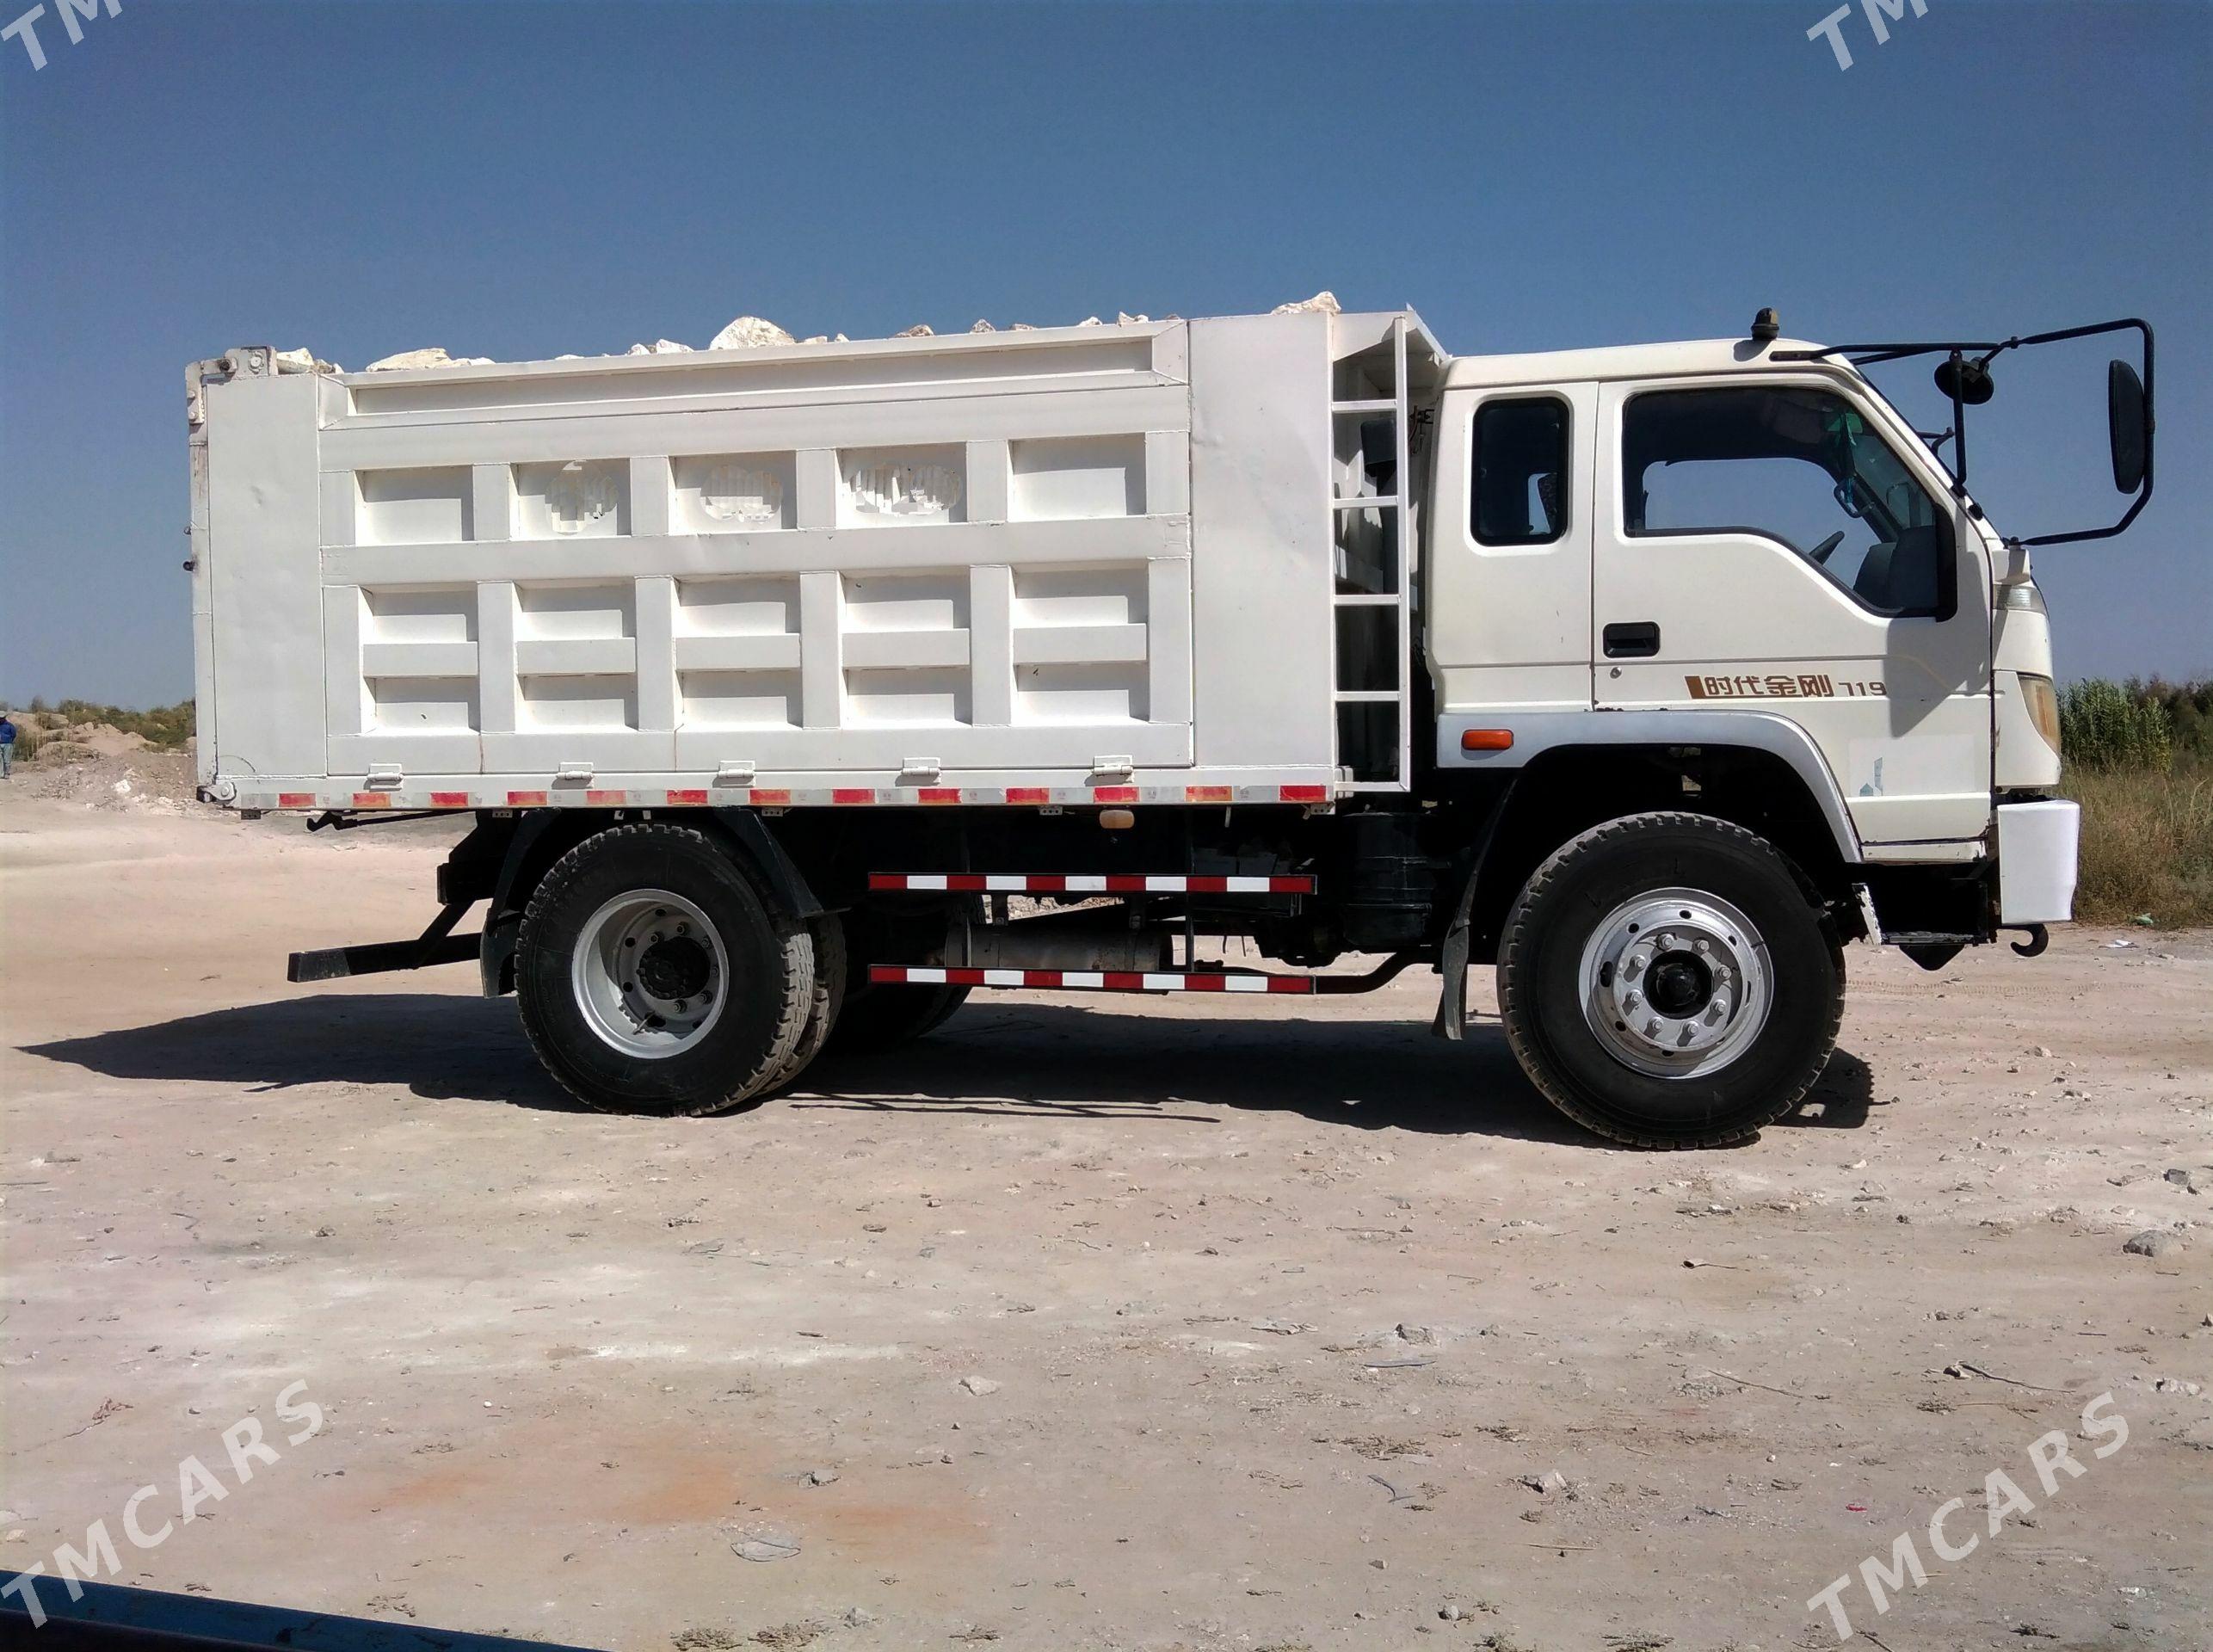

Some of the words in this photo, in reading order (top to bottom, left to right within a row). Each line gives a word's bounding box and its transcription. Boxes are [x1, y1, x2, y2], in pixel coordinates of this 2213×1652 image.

[1704, 675, 1834, 698] 时代金刚
[1838, 681, 1888, 697] 719
